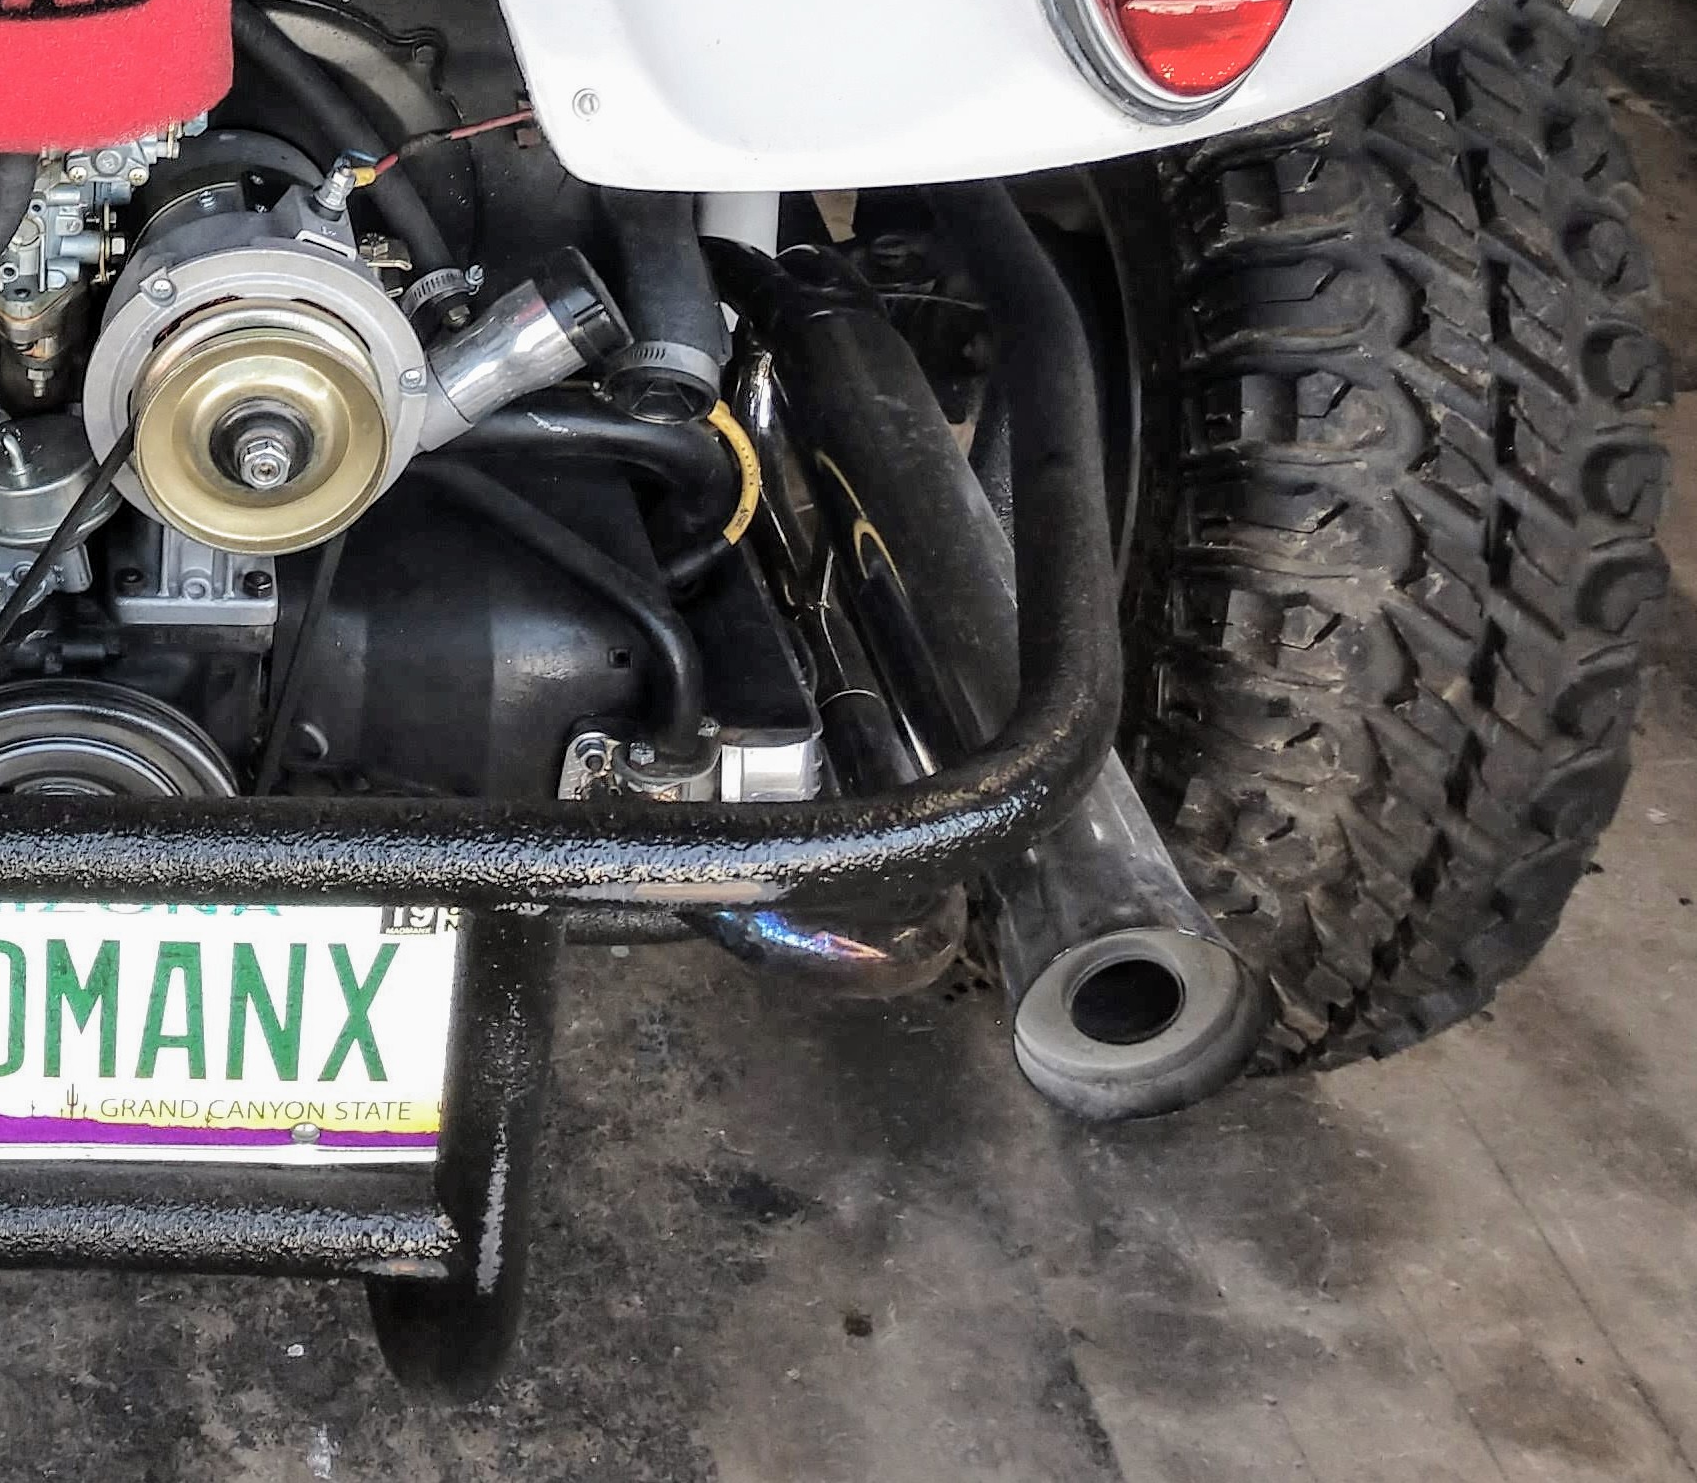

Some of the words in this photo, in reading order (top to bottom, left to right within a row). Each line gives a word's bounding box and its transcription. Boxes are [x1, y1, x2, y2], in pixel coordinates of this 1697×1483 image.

[100, 1098, 199, 1119] GRAND
[207, 1099, 325, 1120] CANYON
[334, 1101, 412, 1121] STATE
